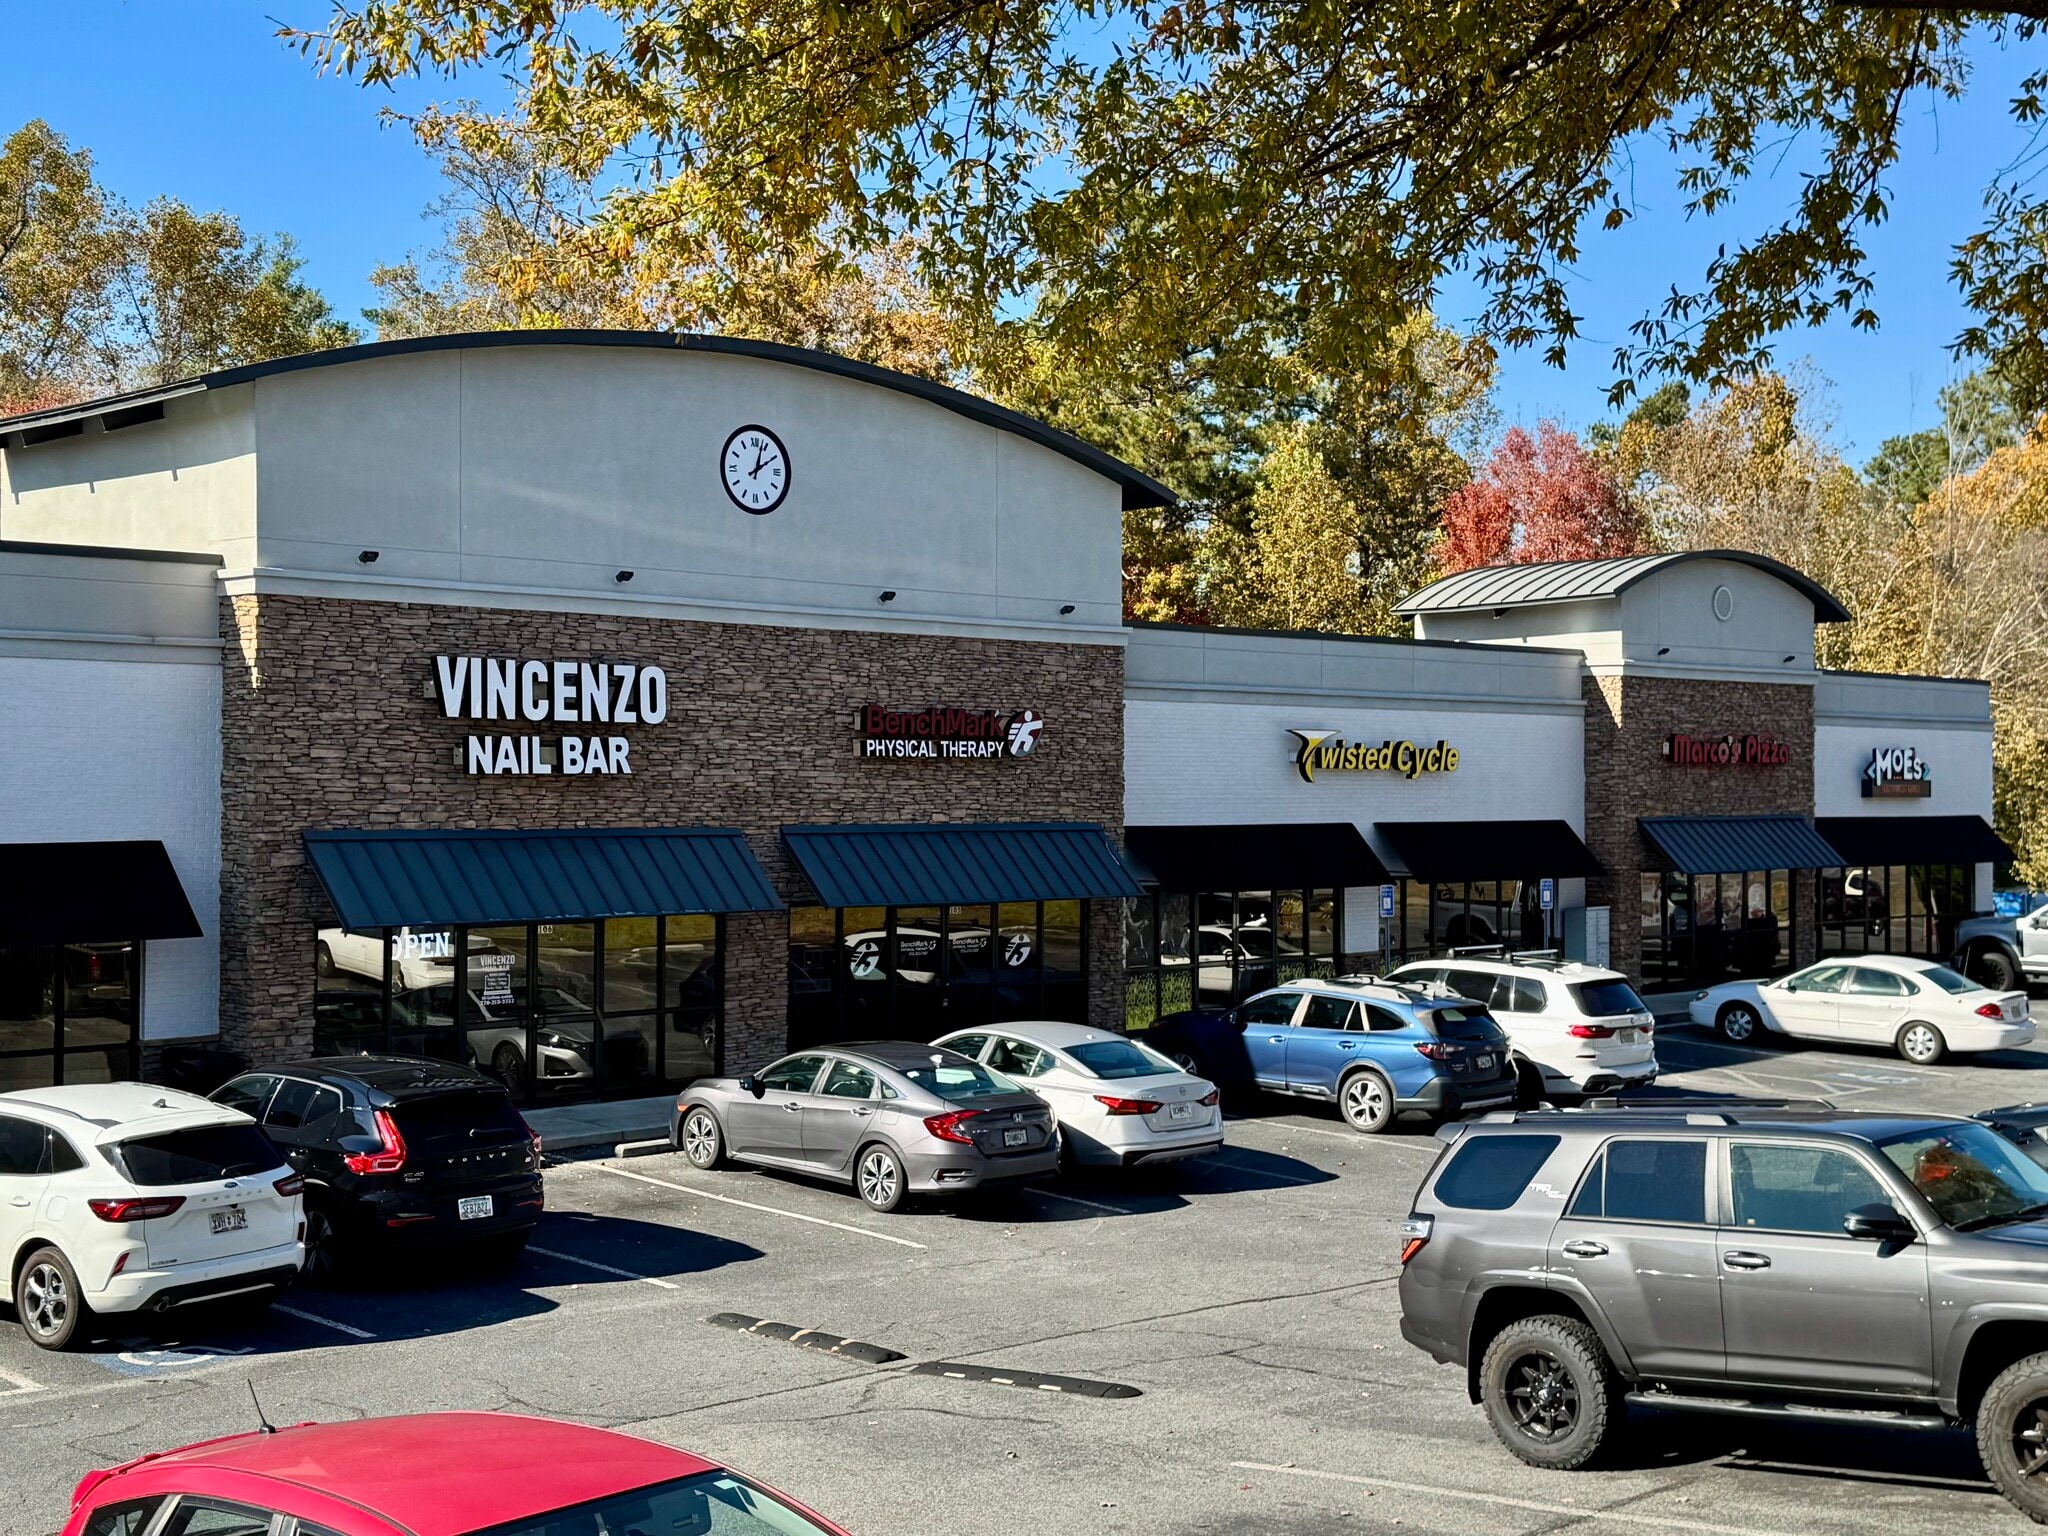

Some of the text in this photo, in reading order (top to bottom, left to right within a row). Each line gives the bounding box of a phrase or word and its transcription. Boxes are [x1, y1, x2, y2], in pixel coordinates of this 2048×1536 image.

[436, 655, 667, 724] VINCENZO
[866, 705, 1005, 737] BenchMark
[468, 736, 632, 775] NAIL BAR
[866, 739, 1005, 758] PHYSICAL THERAPY
[1286, 729, 1460, 783] Twisted Cycle
[1674, 734, 1790, 764] Marco's Pizza
[480, 954, 515, 966] VINCENZO
[448, 1152, 507, 1164] VOLVO
